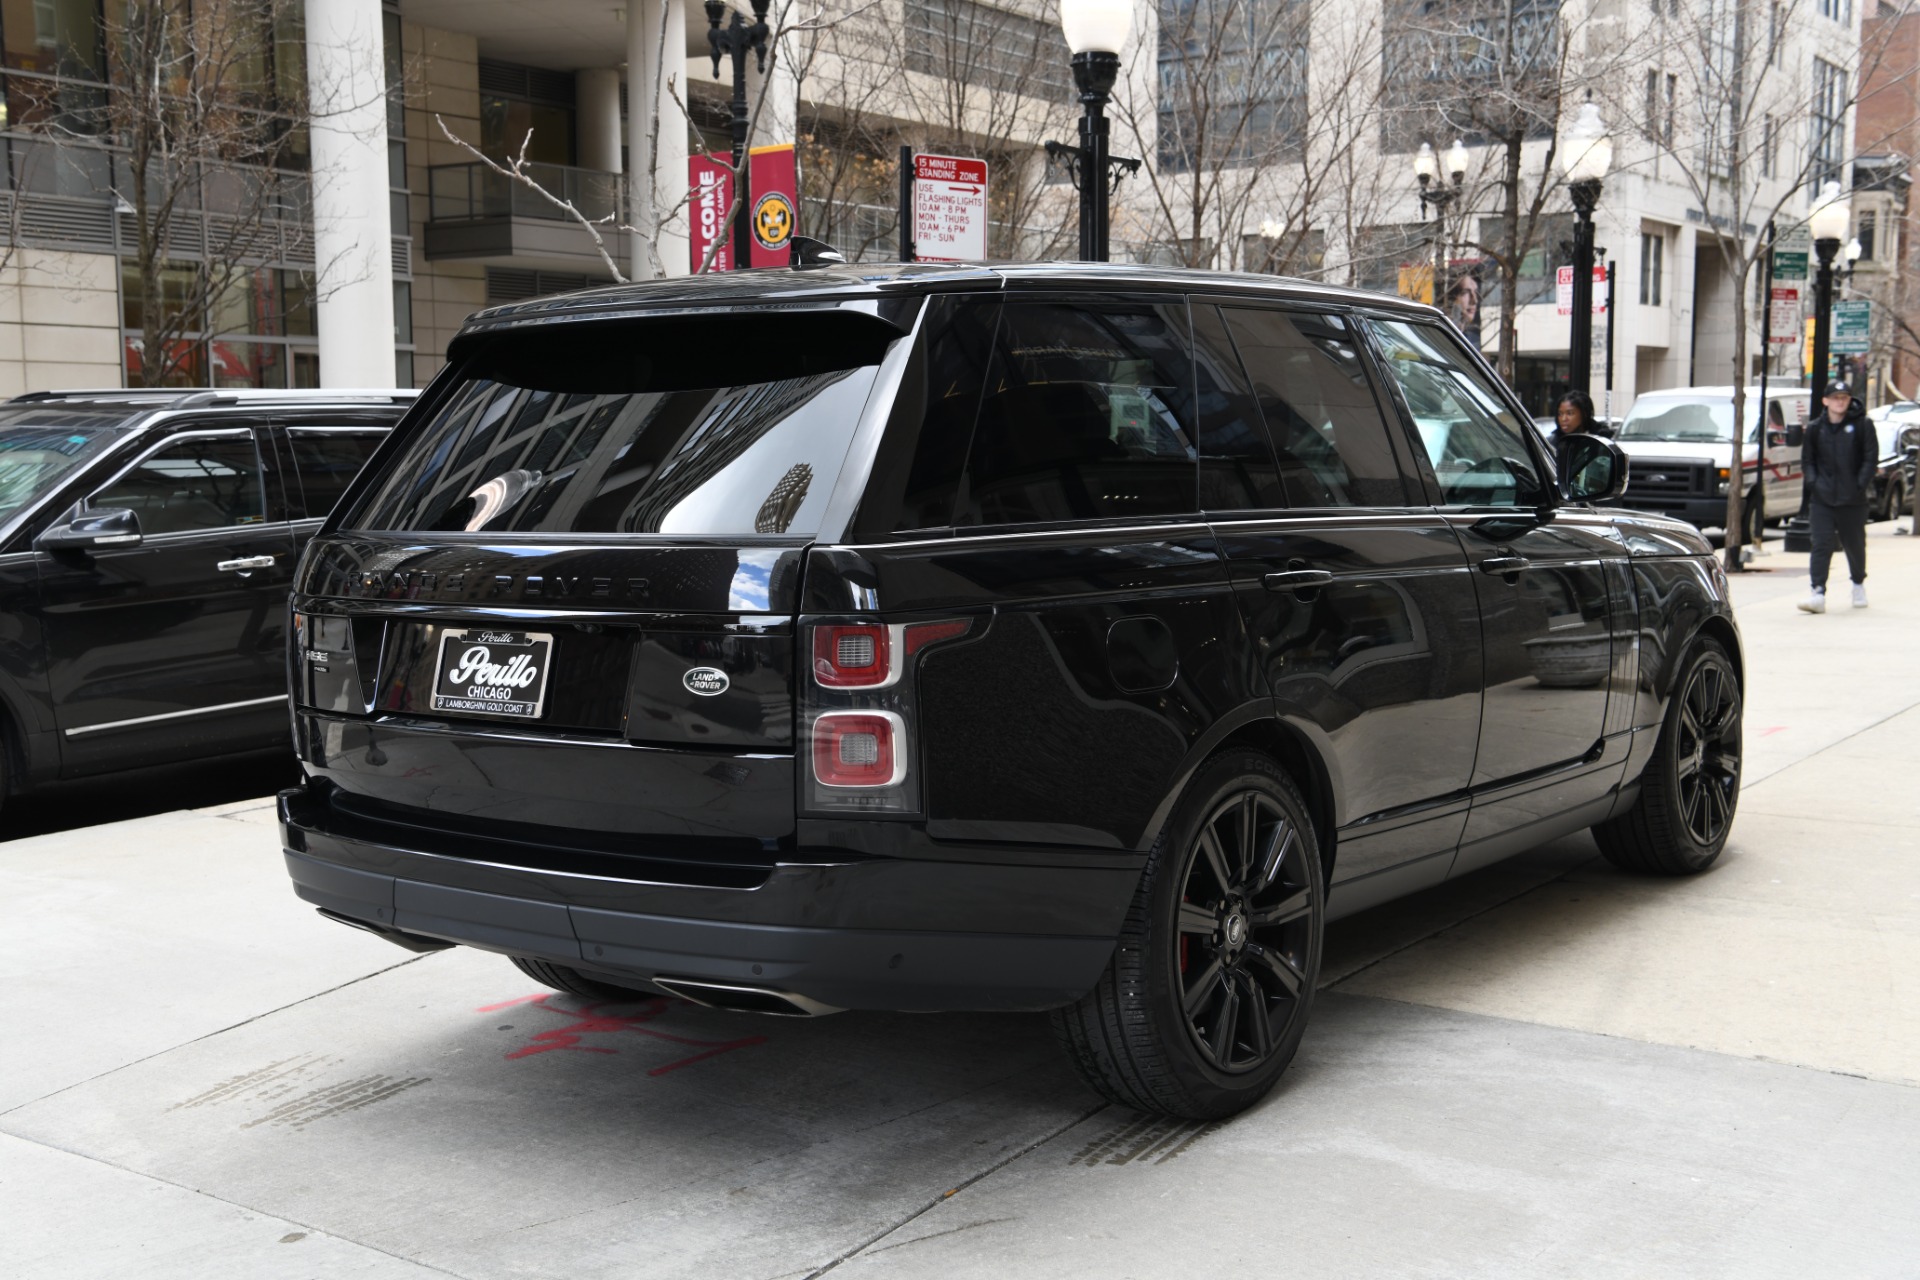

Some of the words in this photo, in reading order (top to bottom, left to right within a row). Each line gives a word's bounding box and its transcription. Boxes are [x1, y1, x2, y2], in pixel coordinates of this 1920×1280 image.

[919, 158, 927, 167] 15
[929, 159, 957, 170] MINUTE
[919, 168, 955, 180] STANDING
[959, 171, 979, 182] ZONE
[918, 183, 934, 193] USE
[918, 193, 955, 205] FLASHING
[957, 197, 982, 207] LIGHTS
[918, 203, 927, 211] 10
[948, 205, 953, 213] 8
[955, 206, 966, 214] PM
[699, 170, 717, 273] ELCOME
[918, 213, 935, 221] MON
[945, 215, 970, 224] THURS
[918, 222, 926, 230] 10
[928, 223, 939, 231] AM
[947, 225, 952, 233] 6
[954, 225, 965, 233] PM
[918, 232, 931, 240] FRI
[938, 234, 955, 242] SUN
[348, 571, 465, 593] RANGE
[494, 575, 651, 597] ROVER
[478, 631, 514, 643] Perillo
[449, 646, 537, 688] Perillo
[692, 672, 714, 681] LAND
[694, 681, 721, 690] ROVER
[467, 685, 512, 700] CHICAGO
[445, 699, 486, 710] LAMBORGHINI
[486, 702, 503, 712] GOLD
[503, 703, 523, 713] COAST
